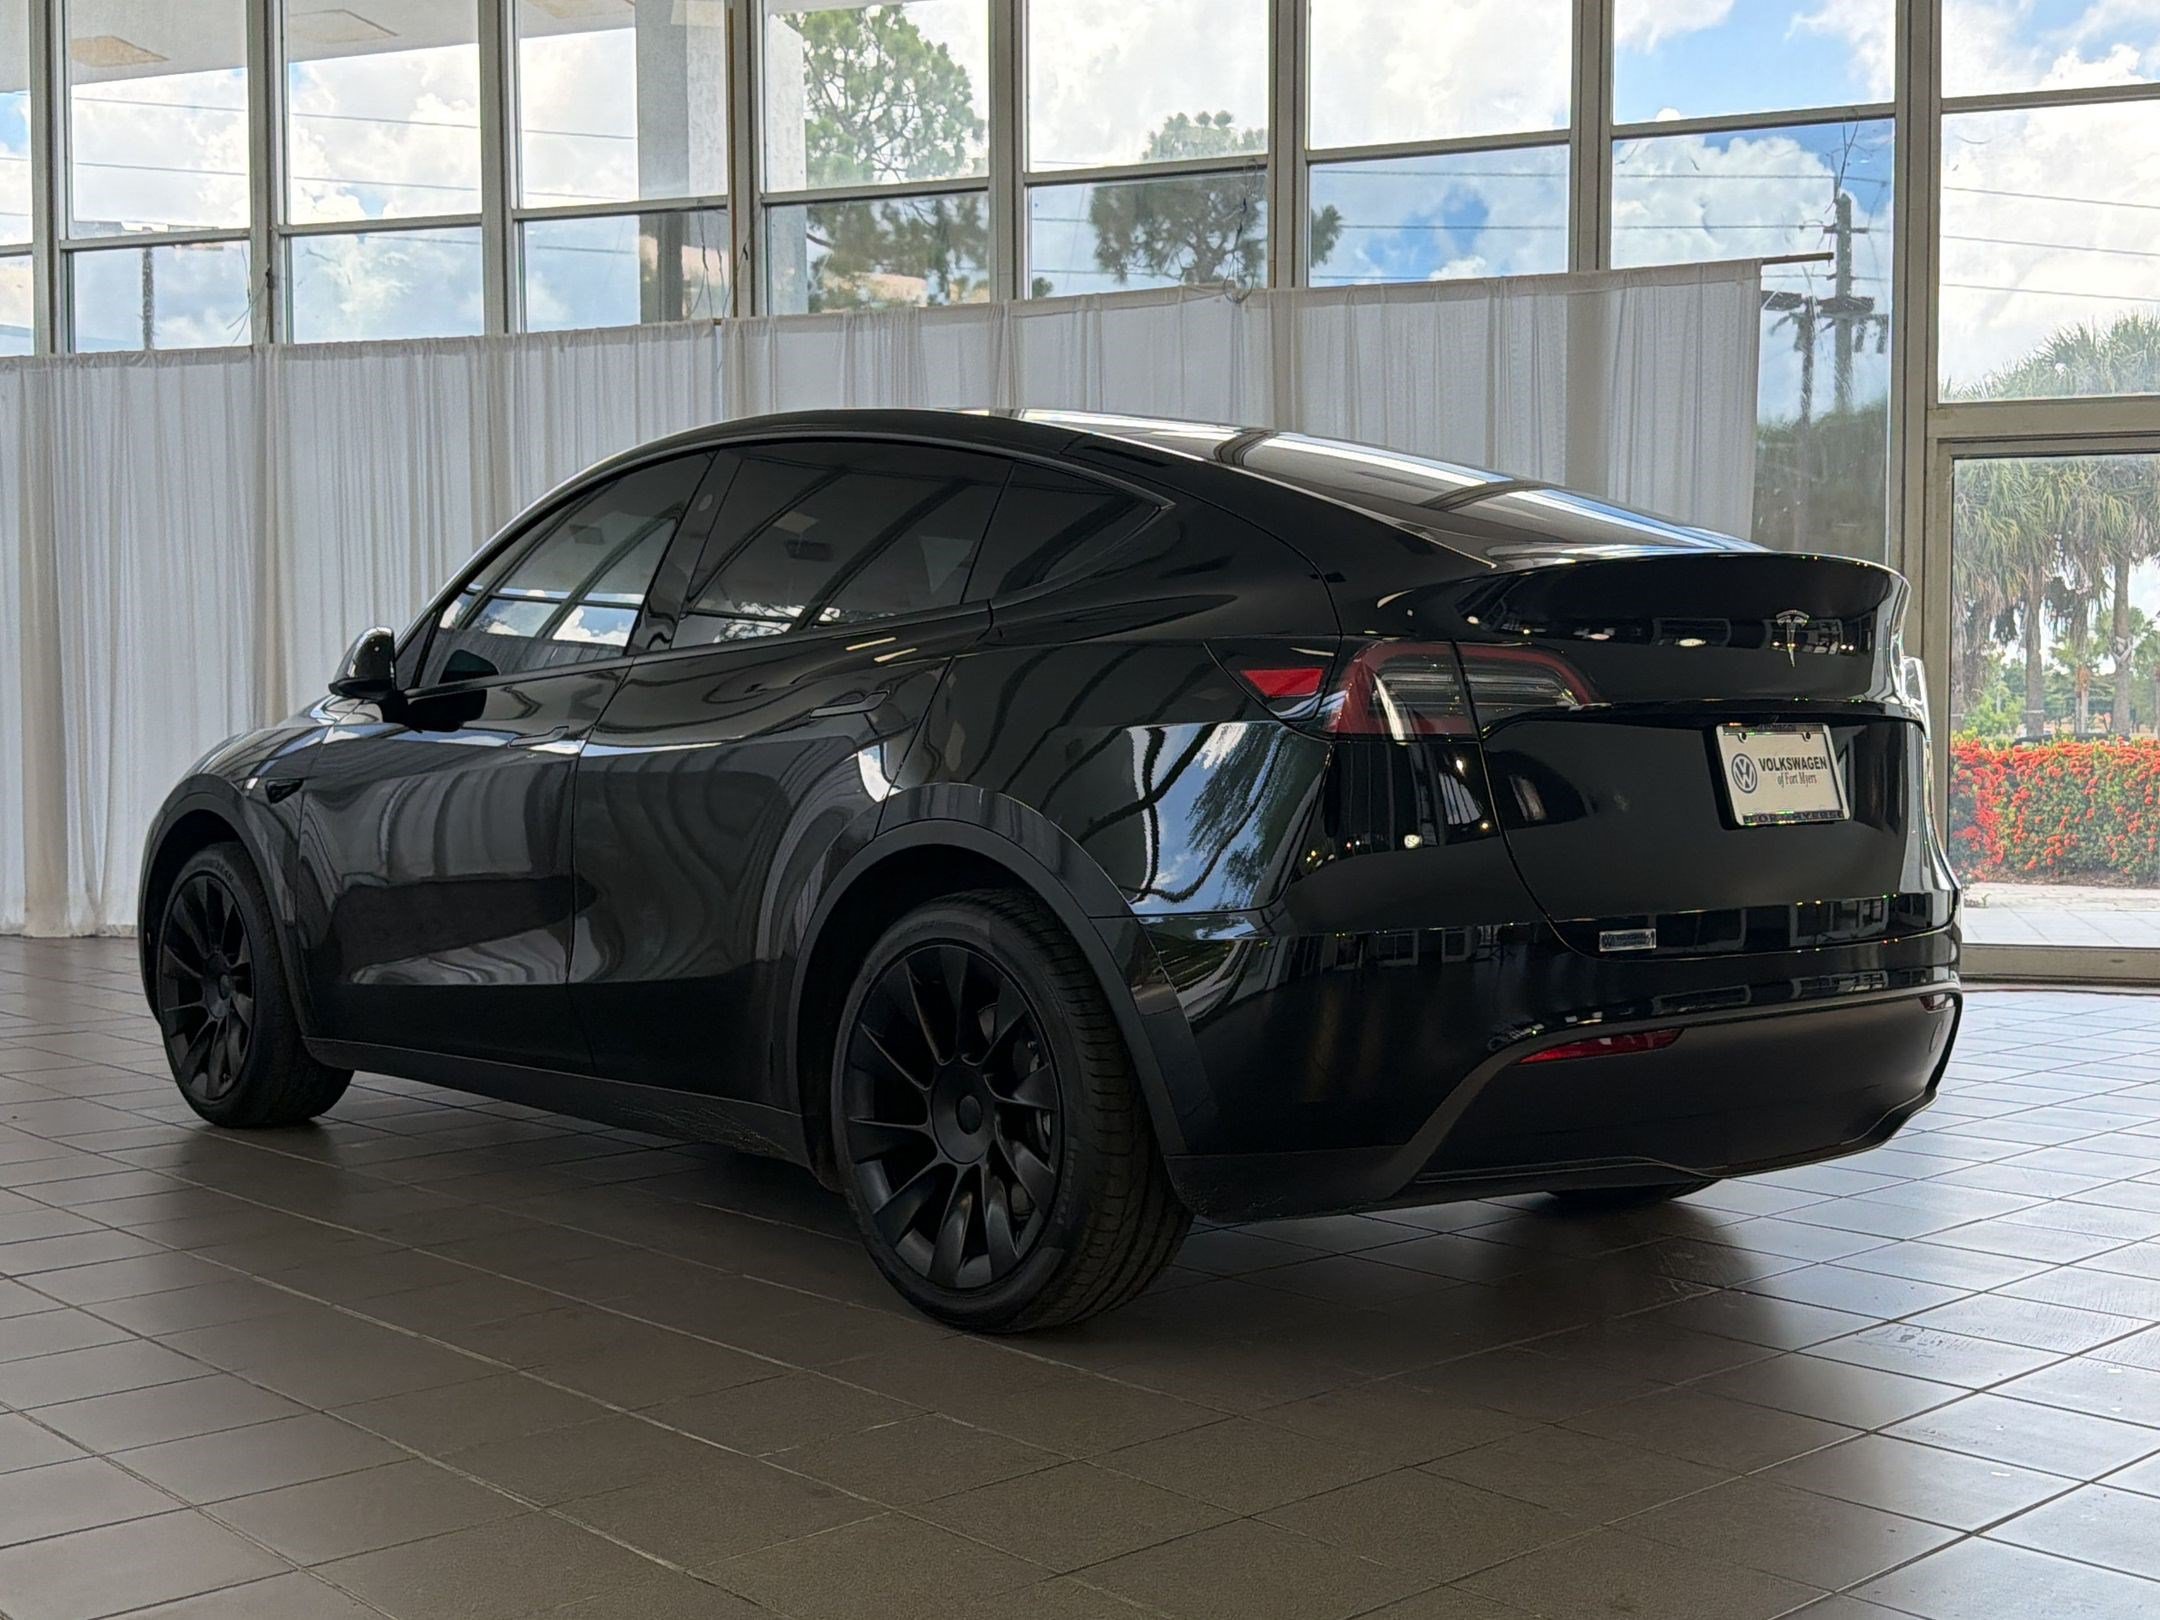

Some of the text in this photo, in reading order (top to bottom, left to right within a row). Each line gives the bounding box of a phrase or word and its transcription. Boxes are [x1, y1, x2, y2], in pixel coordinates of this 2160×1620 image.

[1758, 756, 1828, 771] VOLKSWAGEN
[1777, 772, 1817, 788] of Fort Myers
